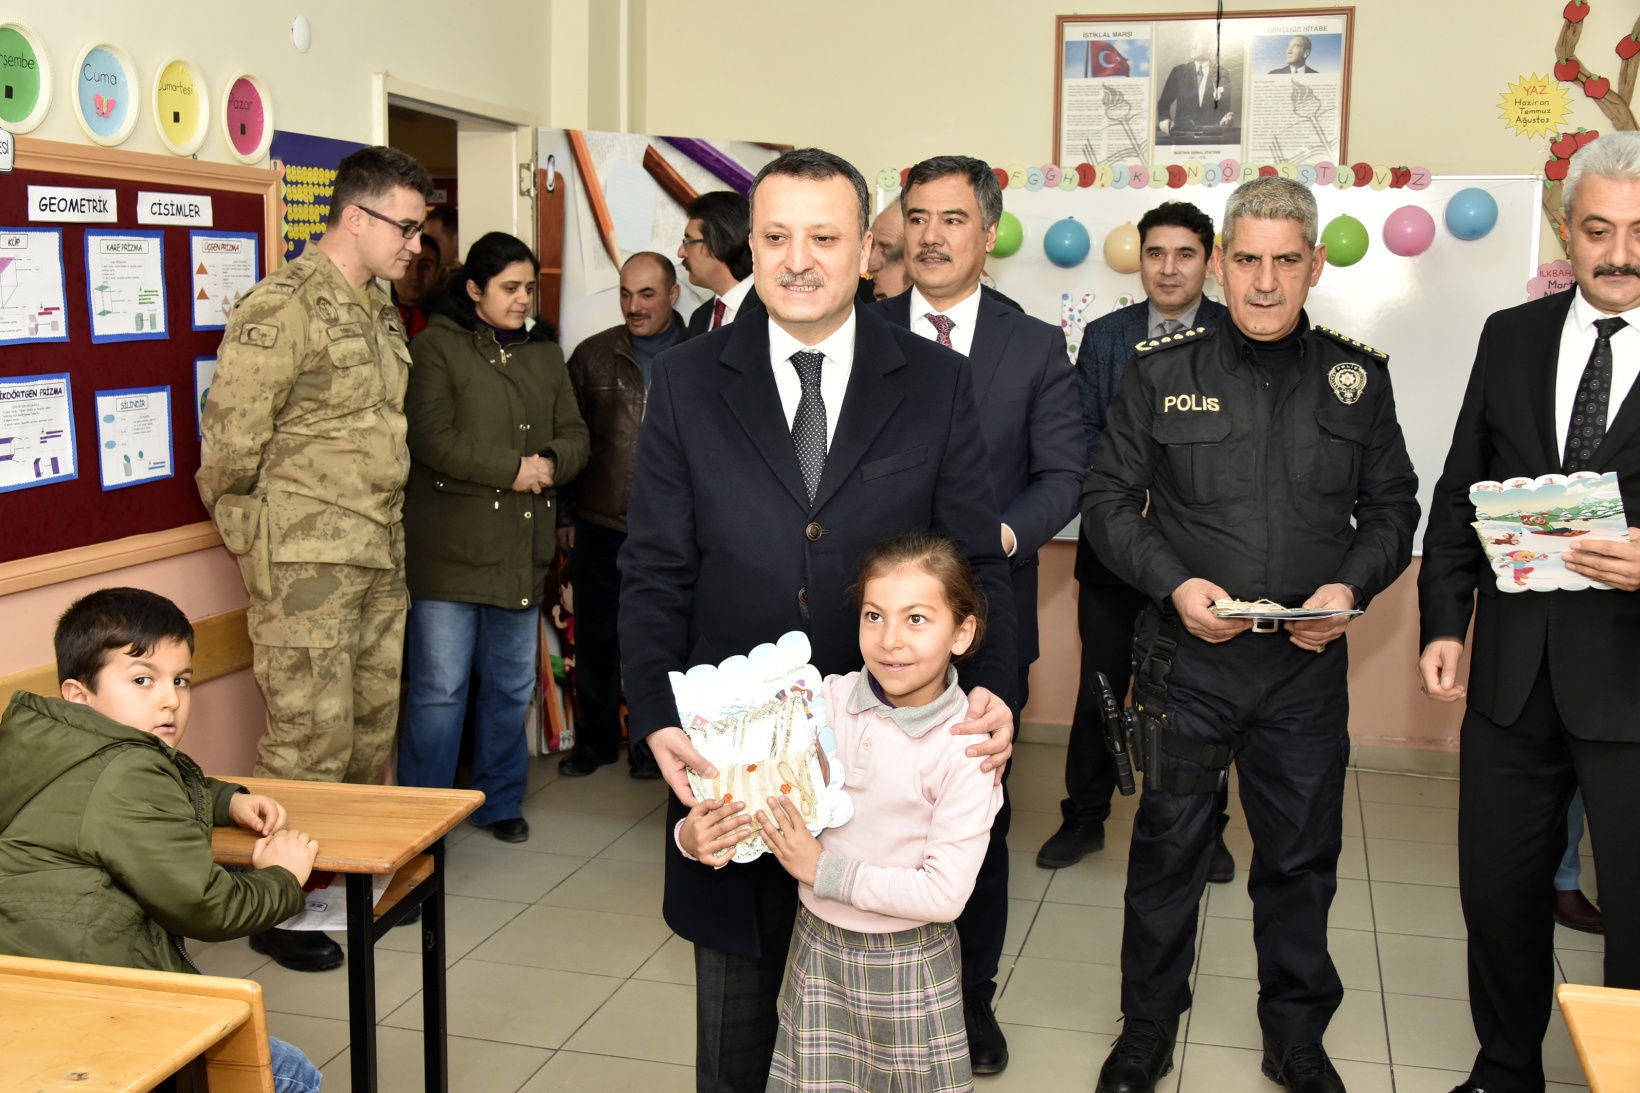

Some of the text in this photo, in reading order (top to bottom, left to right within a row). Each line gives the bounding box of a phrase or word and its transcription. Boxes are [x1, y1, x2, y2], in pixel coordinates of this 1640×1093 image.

[83, 63, 117, 86] Cuma
[1523, 85, 1548, 96] YAZ
[1514, 98, 1550, 106] Haziran
[1519, 107, 1552, 115] Temmuz
[1515, 115, 1550, 128] Ağustos
[1011, 171, 1022, 181] F
[1028, 173, 1039, 186] G
[1045, 167, 1056, 181] Ğ
[1063, 173, 1075, 185] H
[1114, 171, 1122, 183] J
[1132, 171, 1143, 182] K
[1152, 171, 1161, 182] L
[1169, 170, 1181, 181] M
[1187, 167, 1198, 178] N
[1205, 169, 1217, 182] O
[1222, 163, 1234, 178] Ö
[1243, 167, 1253, 180] P
[1319, 166, 1330, 179] T
[1337, 173, 1349, 185] U
[1356, 166, 1368, 181] Ü
[1374, 172, 1388, 185] V
[1394, 172, 1405, 185] Y
[1411, 173, 1425, 186] Z
[38, 195, 201, 218] GEOMETRİK CİSİMLER
[7, 236, 21, 247] KÜP
[106, 242, 143, 252] KARE PRİZMA
[220, 243, 240, 252] PRİZMA
[39, 386, 63, 397] PRİZMA
[120, 398, 146, 410] SİLİNDİR
